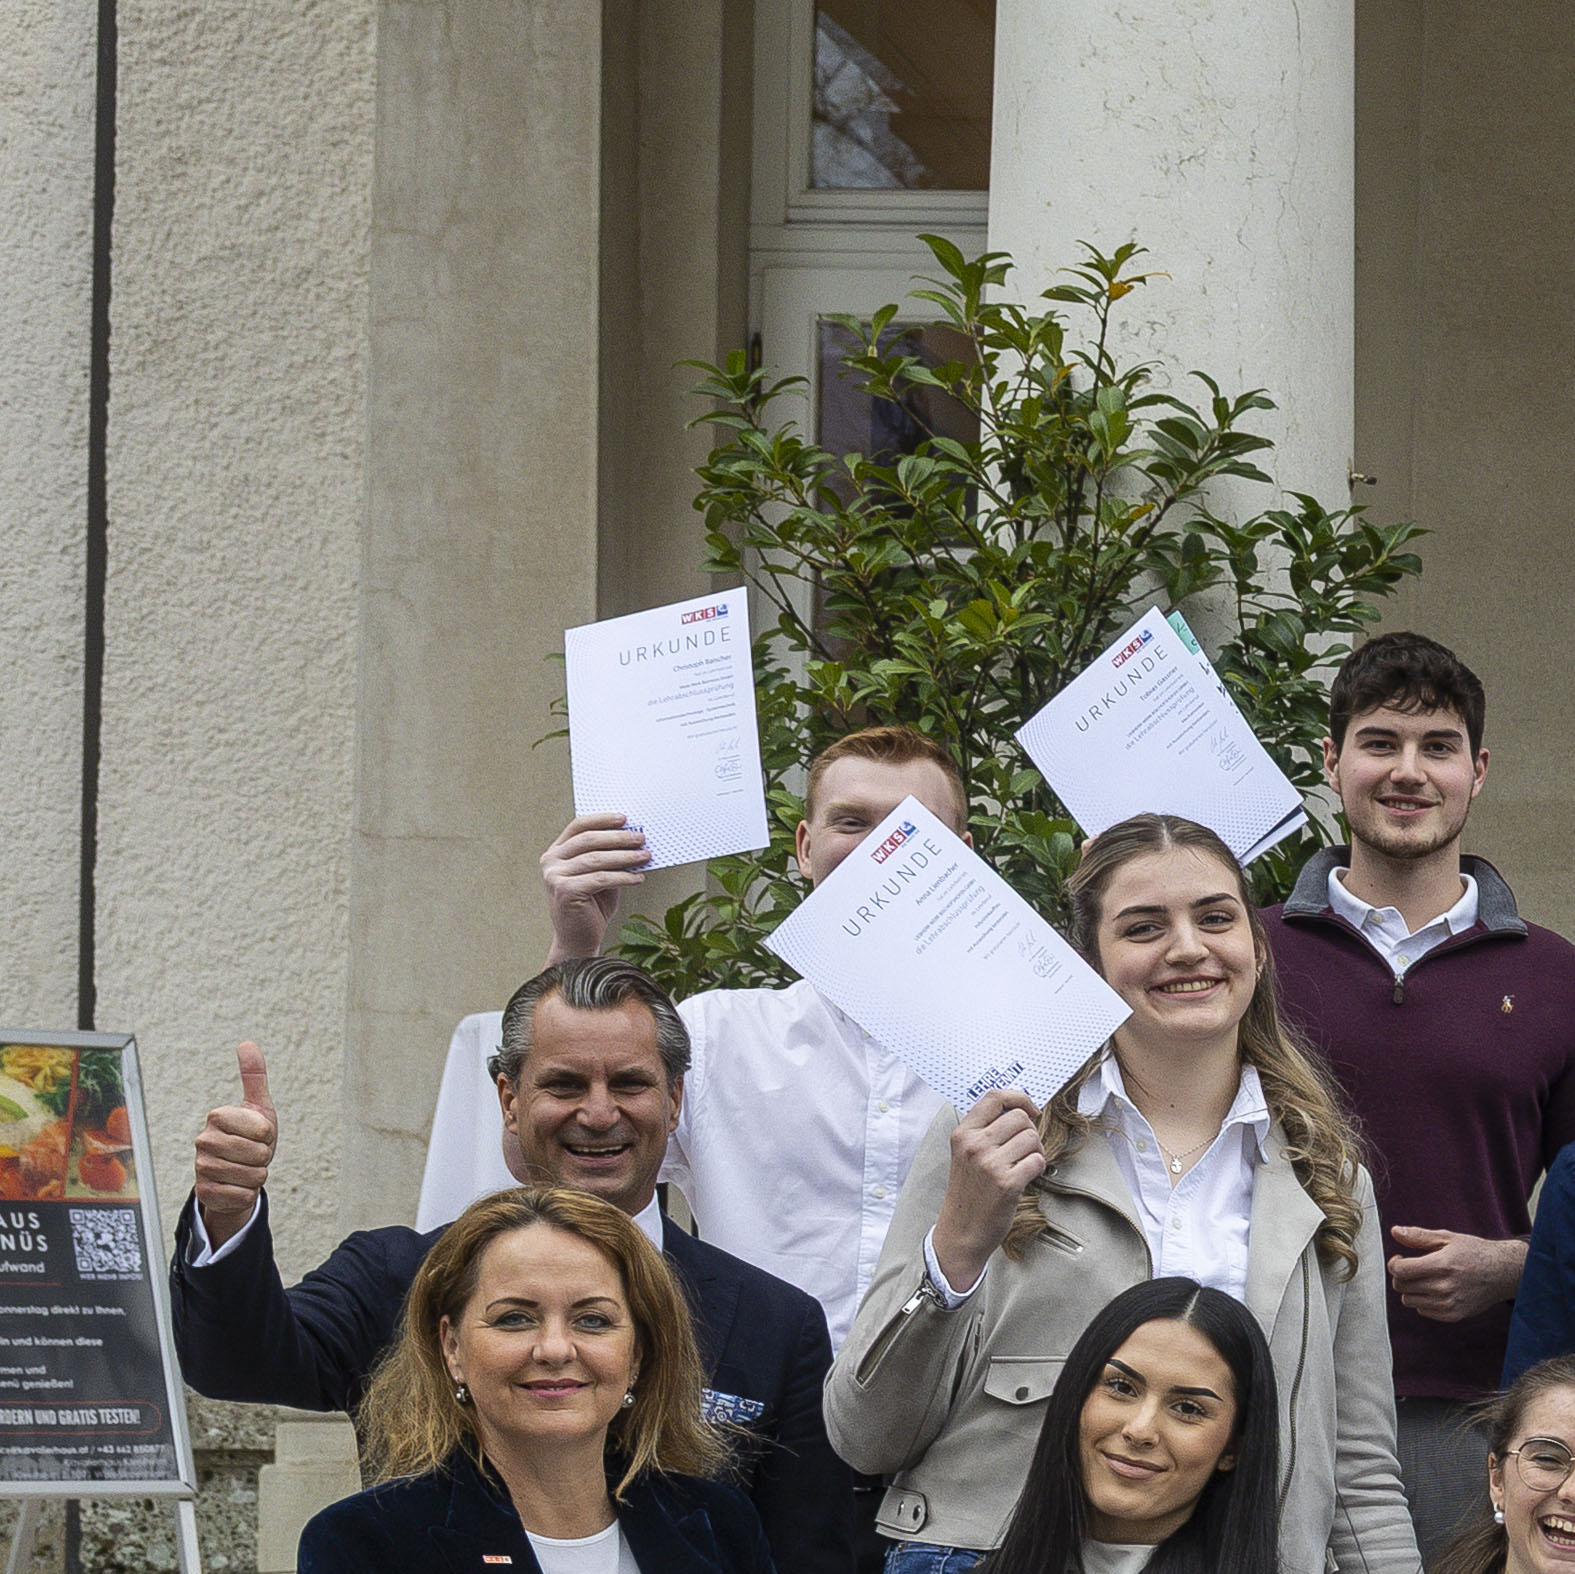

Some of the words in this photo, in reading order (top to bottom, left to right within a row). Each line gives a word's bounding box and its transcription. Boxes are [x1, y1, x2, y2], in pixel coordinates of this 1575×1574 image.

[681, 607, 715, 624] WKS
[619, 625, 731, 666] URKUNDE
[1111, 637, 1143, 668] WKS
[1073, 643, 1169, 734] URKUNDE
[871, 829, 906, 864] WKS
[840, 836, 943, 939] URKUNDE
[965, 1065, 1002, 1102] LEHRE
[35, 1409, 57, 1425] UND
[58, 1409, 98, 1425] GRATIS
